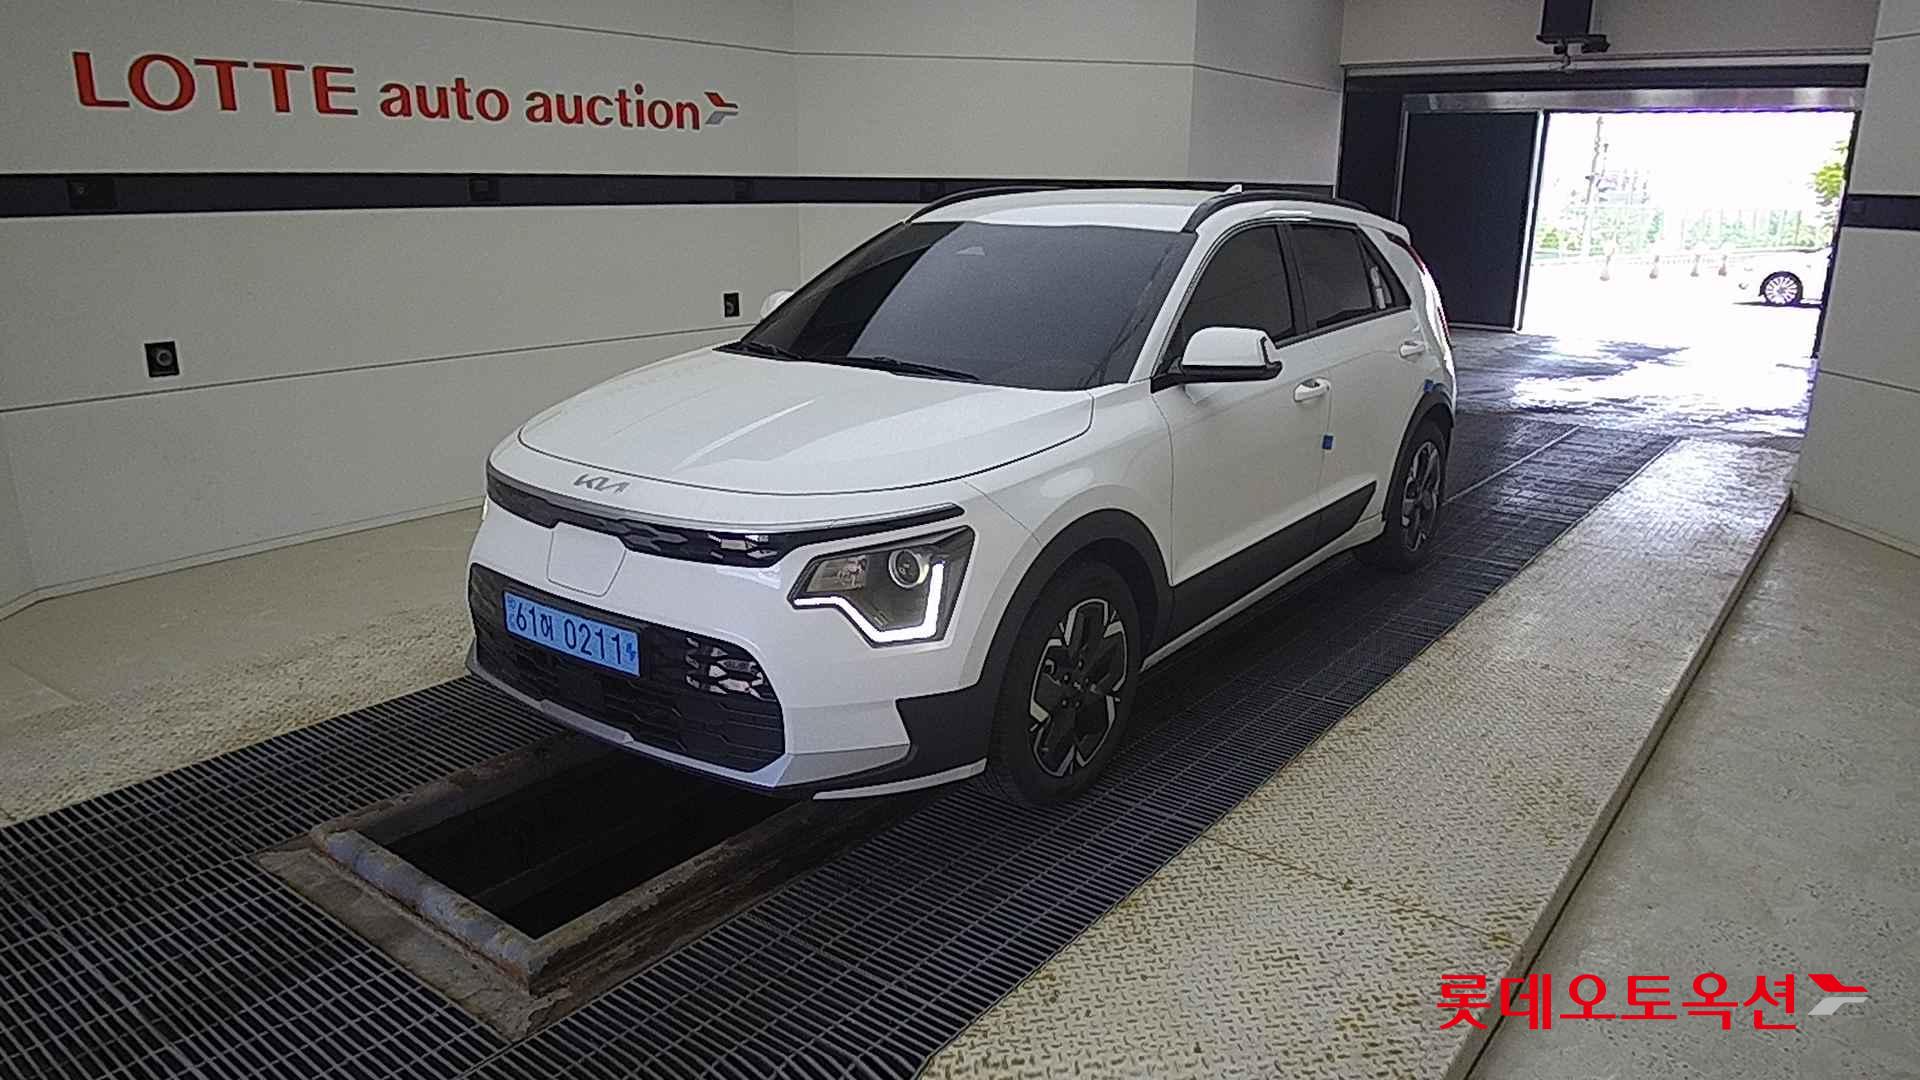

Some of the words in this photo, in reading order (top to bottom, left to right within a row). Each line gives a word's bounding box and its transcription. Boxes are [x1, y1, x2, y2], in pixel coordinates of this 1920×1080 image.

[72, 51, 358, 116] LOTTE
[379, 76, 509, 123] auto
[525, 84, 700, 130] auction
[564, 618, 621, 665] 0211
